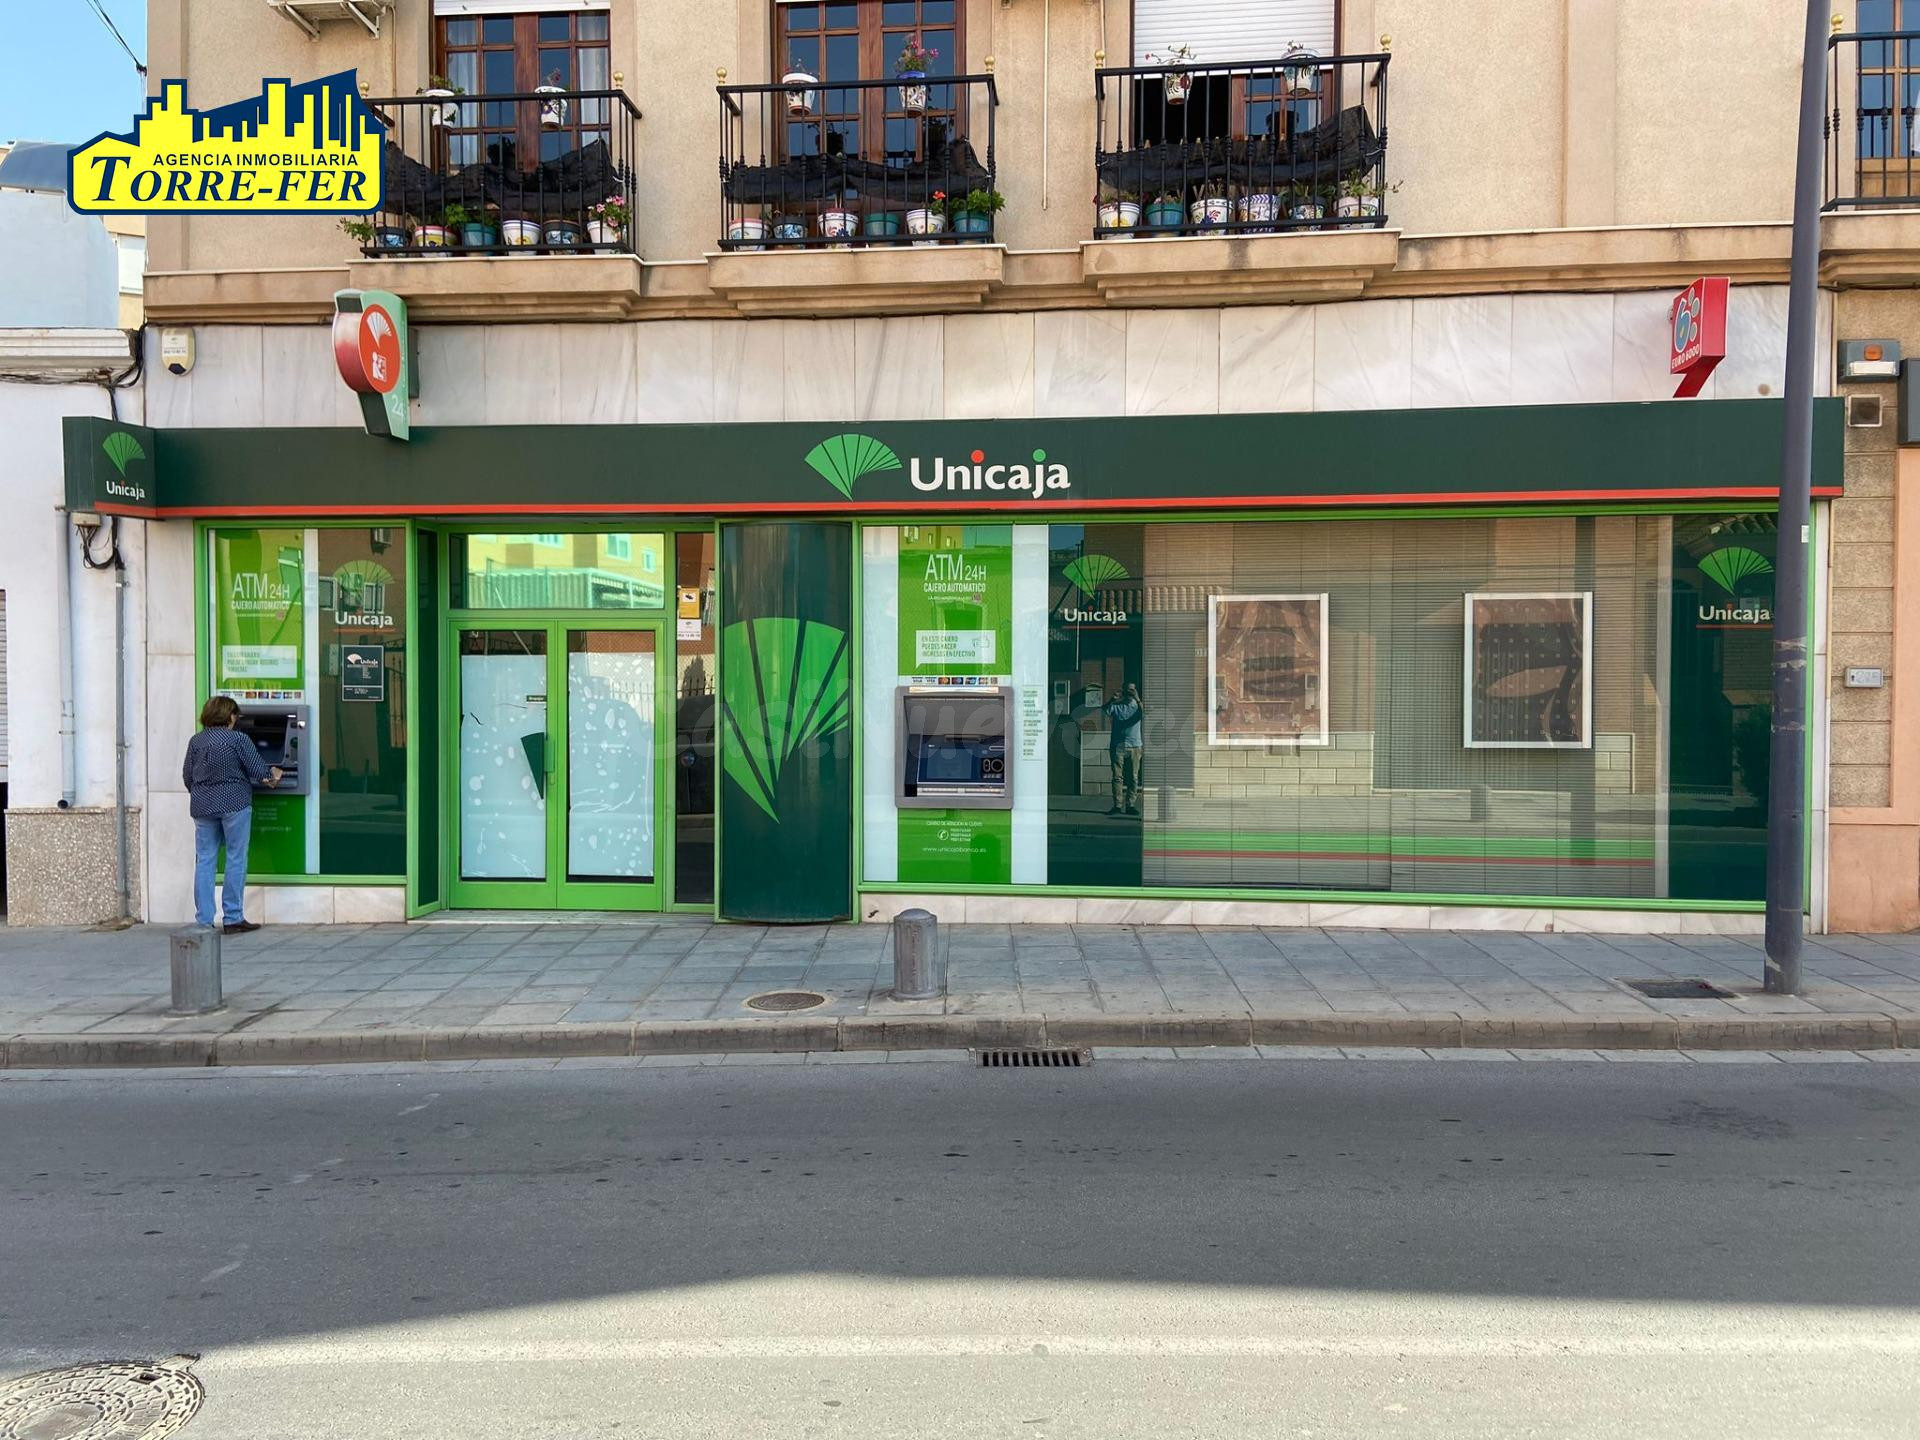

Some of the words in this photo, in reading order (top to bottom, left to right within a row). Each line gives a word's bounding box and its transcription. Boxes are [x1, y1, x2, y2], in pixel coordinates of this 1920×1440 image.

[1671, 355, 1686, 369] EURO
[1685, 343, 1700, 362] 6000
[911, 448, 1071, 499] Unicaja
[105, 480, 146, 501] Unicaja
[924, 553, 964, 581] ATM
[964, 565, 987, 581] 24H
[231, 573, 268, 599] ATM
[269, 583, 290, 599] 24H
[923, 582, 946, 593] CAJERO
[231, 601, 252, 610] CAJERO
[1063, 605, 1128, 625] Unicaja
[1699, 603, 1771, 625] Unicaja
[334, 608, 394, 628] Unicaja
